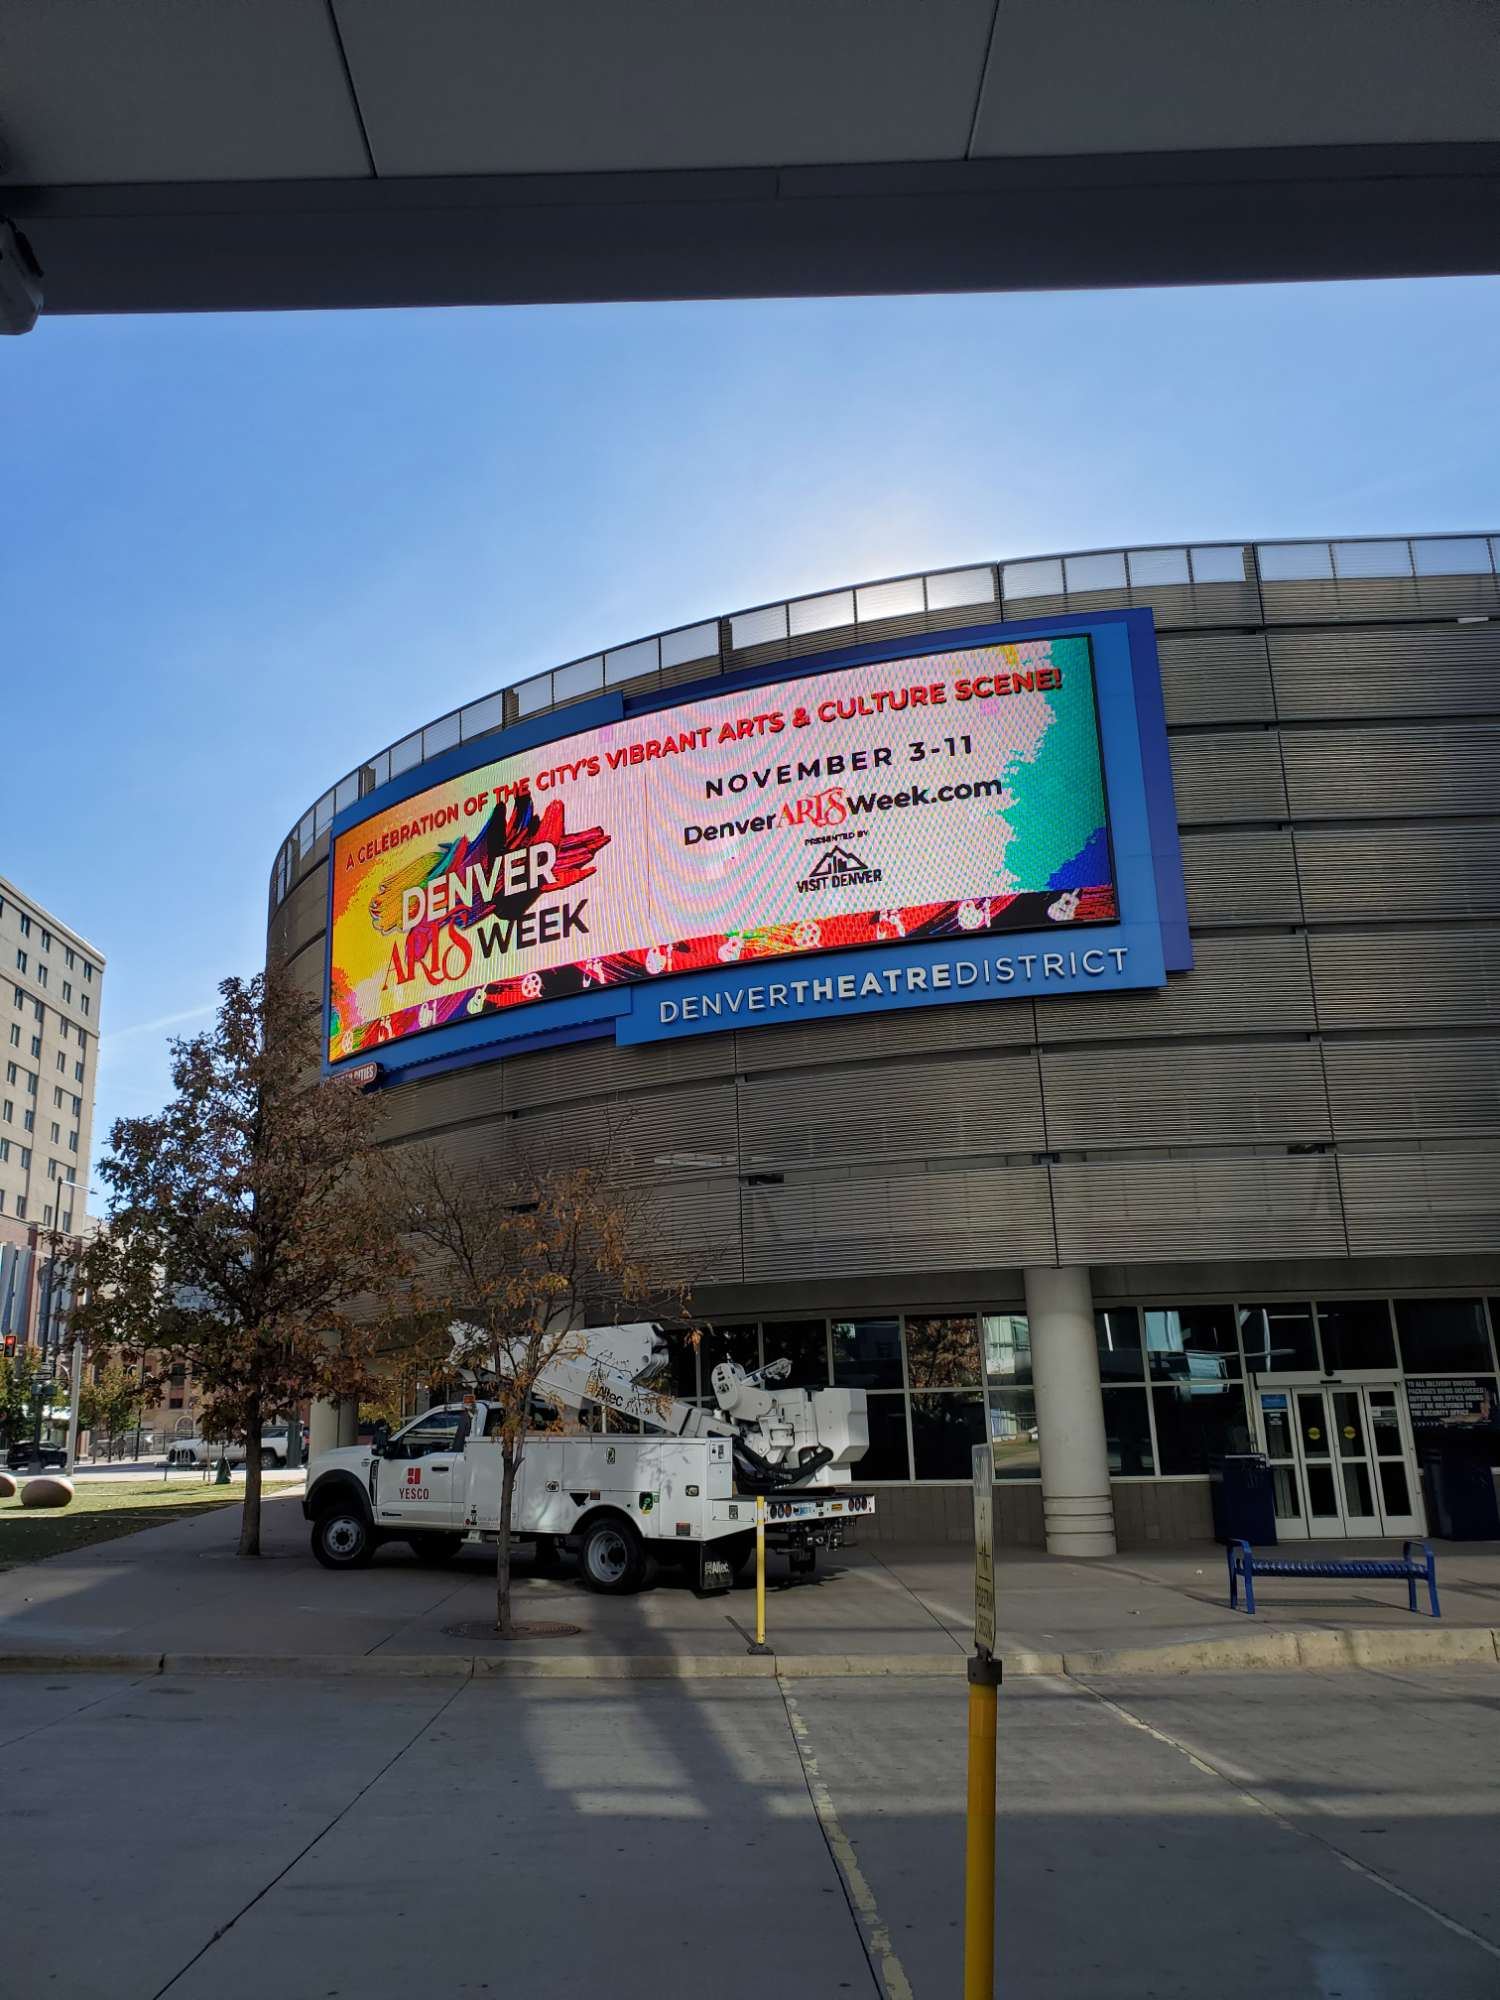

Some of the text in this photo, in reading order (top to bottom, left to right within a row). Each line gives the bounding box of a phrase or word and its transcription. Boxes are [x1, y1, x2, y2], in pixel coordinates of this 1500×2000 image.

[345, 668, 1064, 871] A CELEBRATION OF THE CITY'S VIBRANT ARTS & CULTURE SCENE!
[705, 735, 973, 799] NOVEMBER 3-11
[804, 829, 869, 846] PRESENTED BY
[401, 841, 557, 932] DENVER
[796, 868, 883, 893] VISIT DENVER
[382, 906, 473, 991] ARTS
[477, 898, 590, 959] WEEK
[399, 1488, 429, 1500] YESCO
